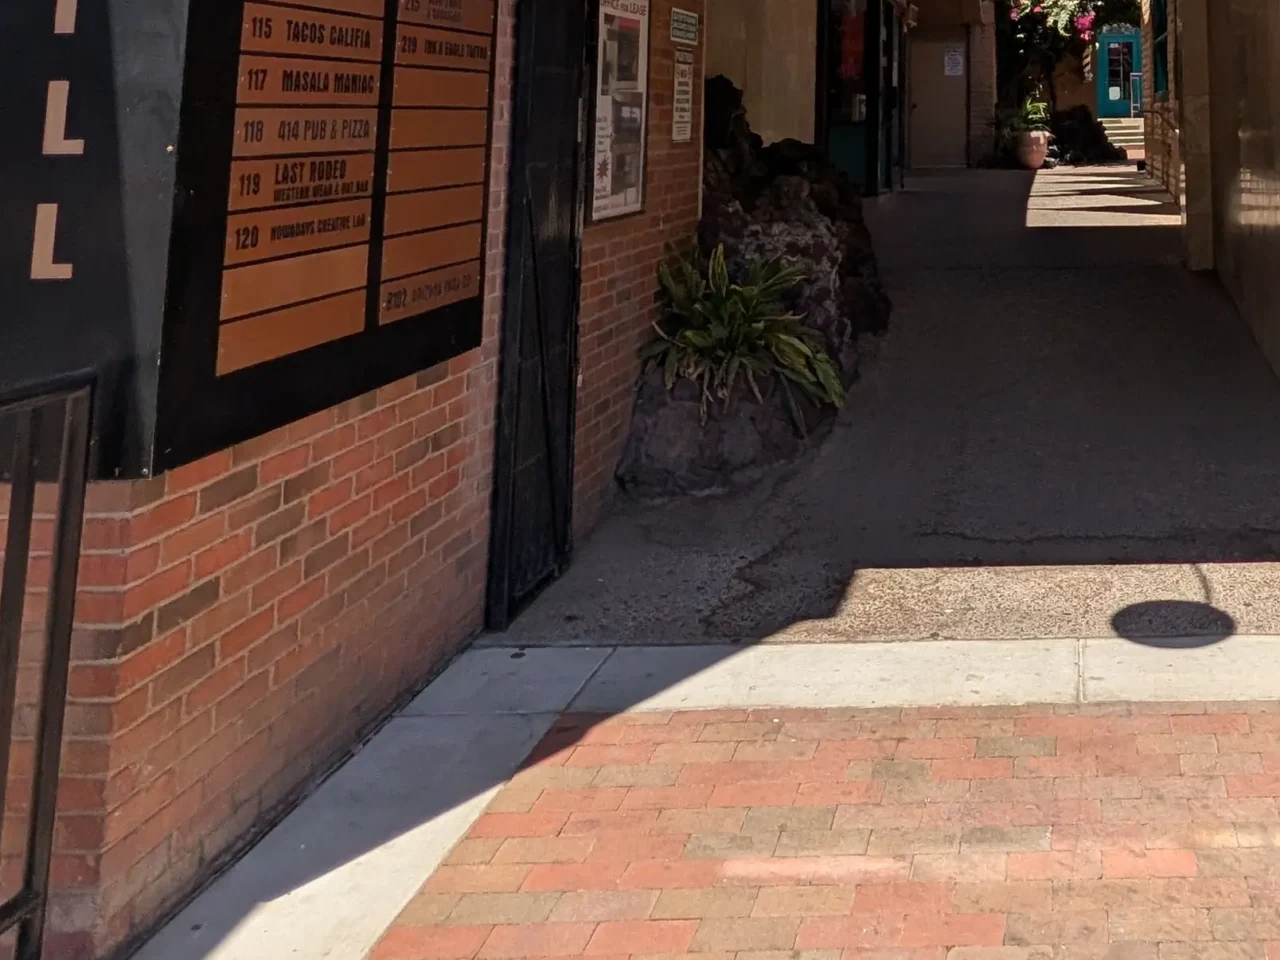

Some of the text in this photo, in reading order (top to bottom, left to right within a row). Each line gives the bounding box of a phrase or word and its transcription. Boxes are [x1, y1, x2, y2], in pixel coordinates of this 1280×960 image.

[251, 17, 272, 39] 115
[286, 20, 326, 45] TACOS
[247, 68, 374, 94] 117 MASALA MANIAC
[244, 118, 370, 142] 118 414 PUB & PIZZA
[239, 160, 347, 196] 119 LAST RODEO
[235, 225, 259, 251] 120
